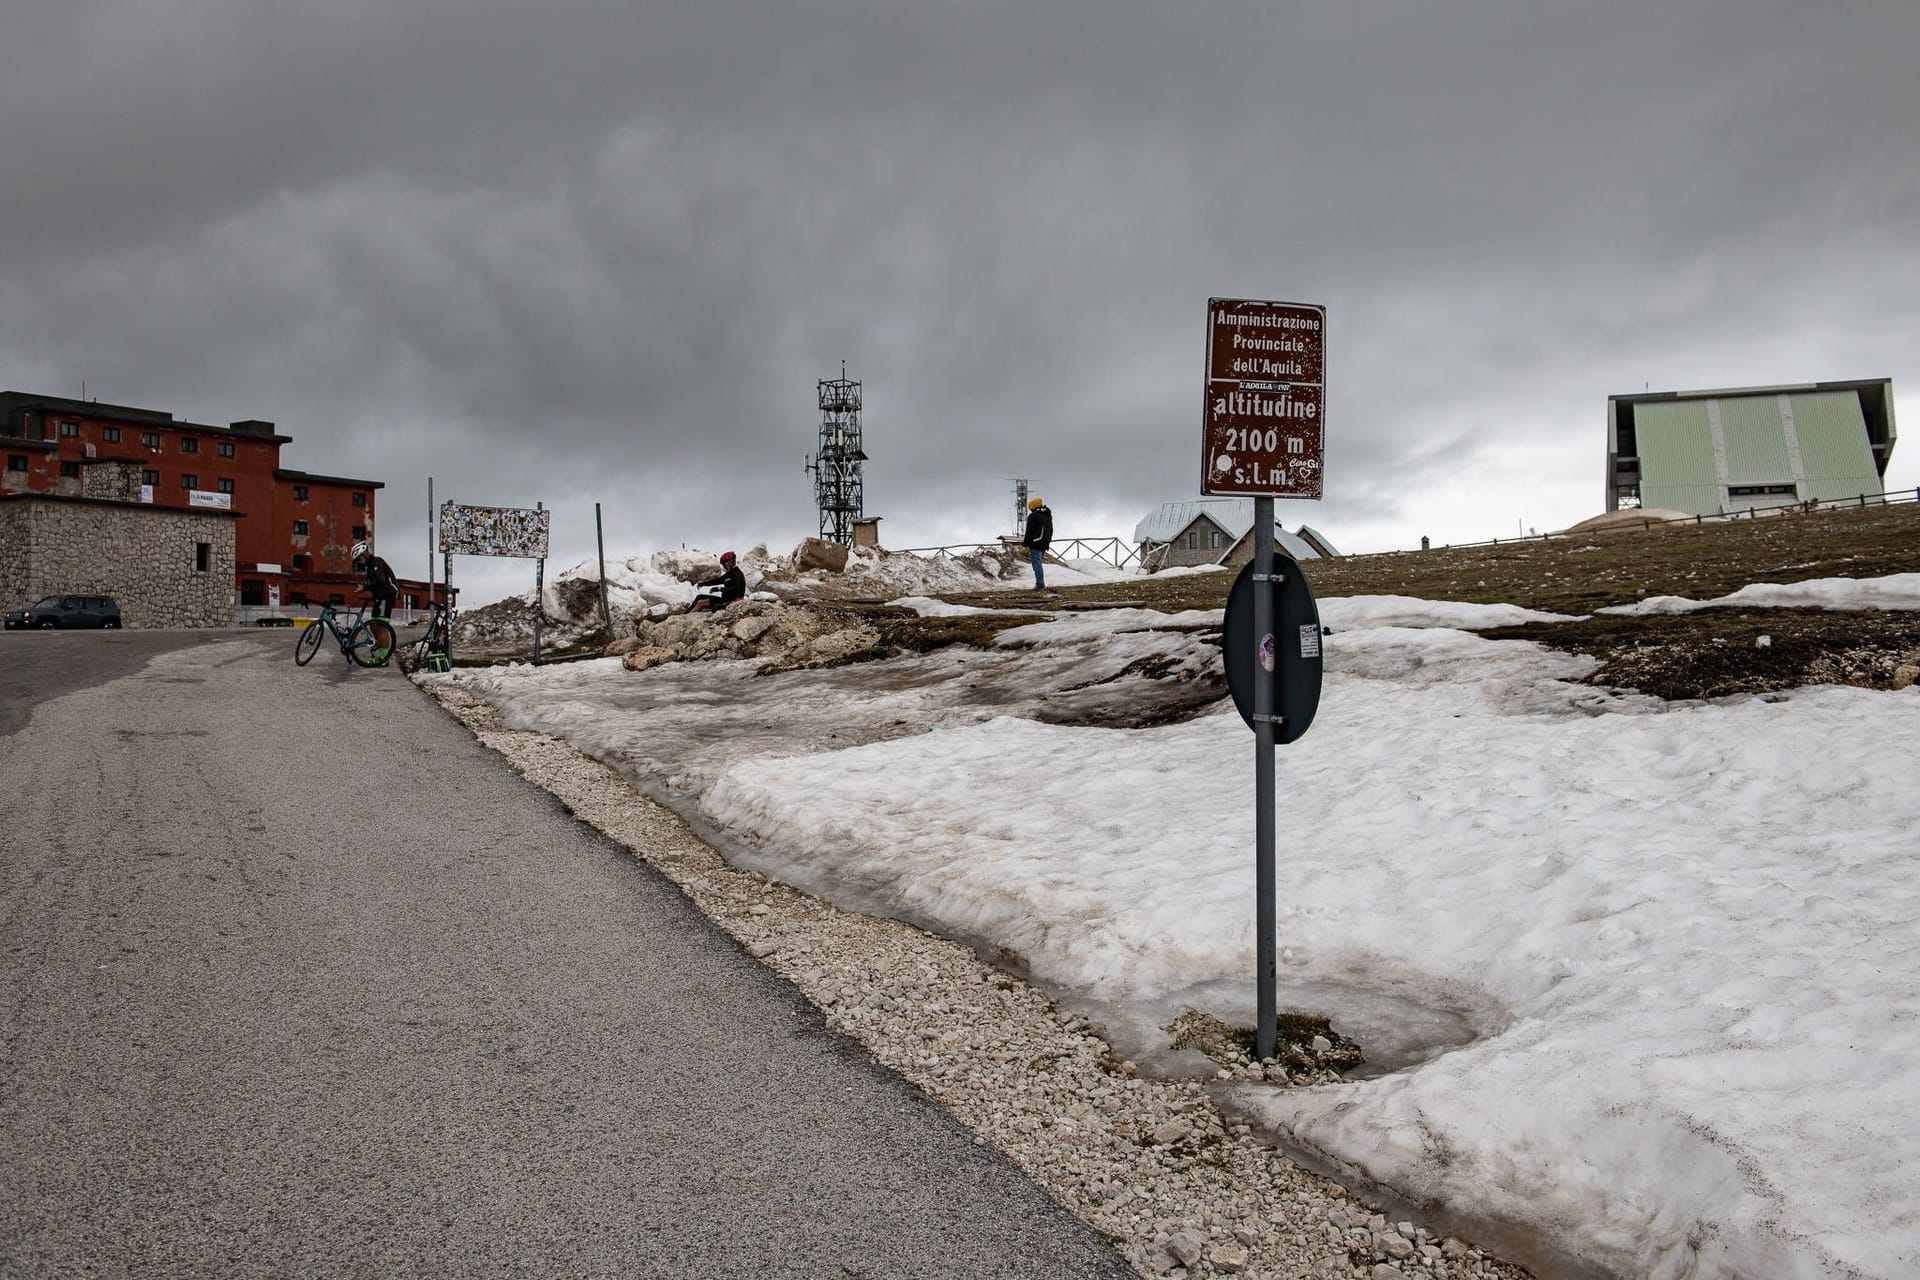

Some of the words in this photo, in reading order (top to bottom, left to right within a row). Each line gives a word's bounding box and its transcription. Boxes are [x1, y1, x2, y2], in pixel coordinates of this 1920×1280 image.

[1217, 310, 1320, 331] Amministrazione
[1233, 334, 1304, 352] Provinciale
[1234, 358, 1302, 377] dell'Aquila
[1216, 392, 1316, 418] altitudine
[1226, 428, 1277, 453] 2100
[1288, 436, 1304, 454] m
